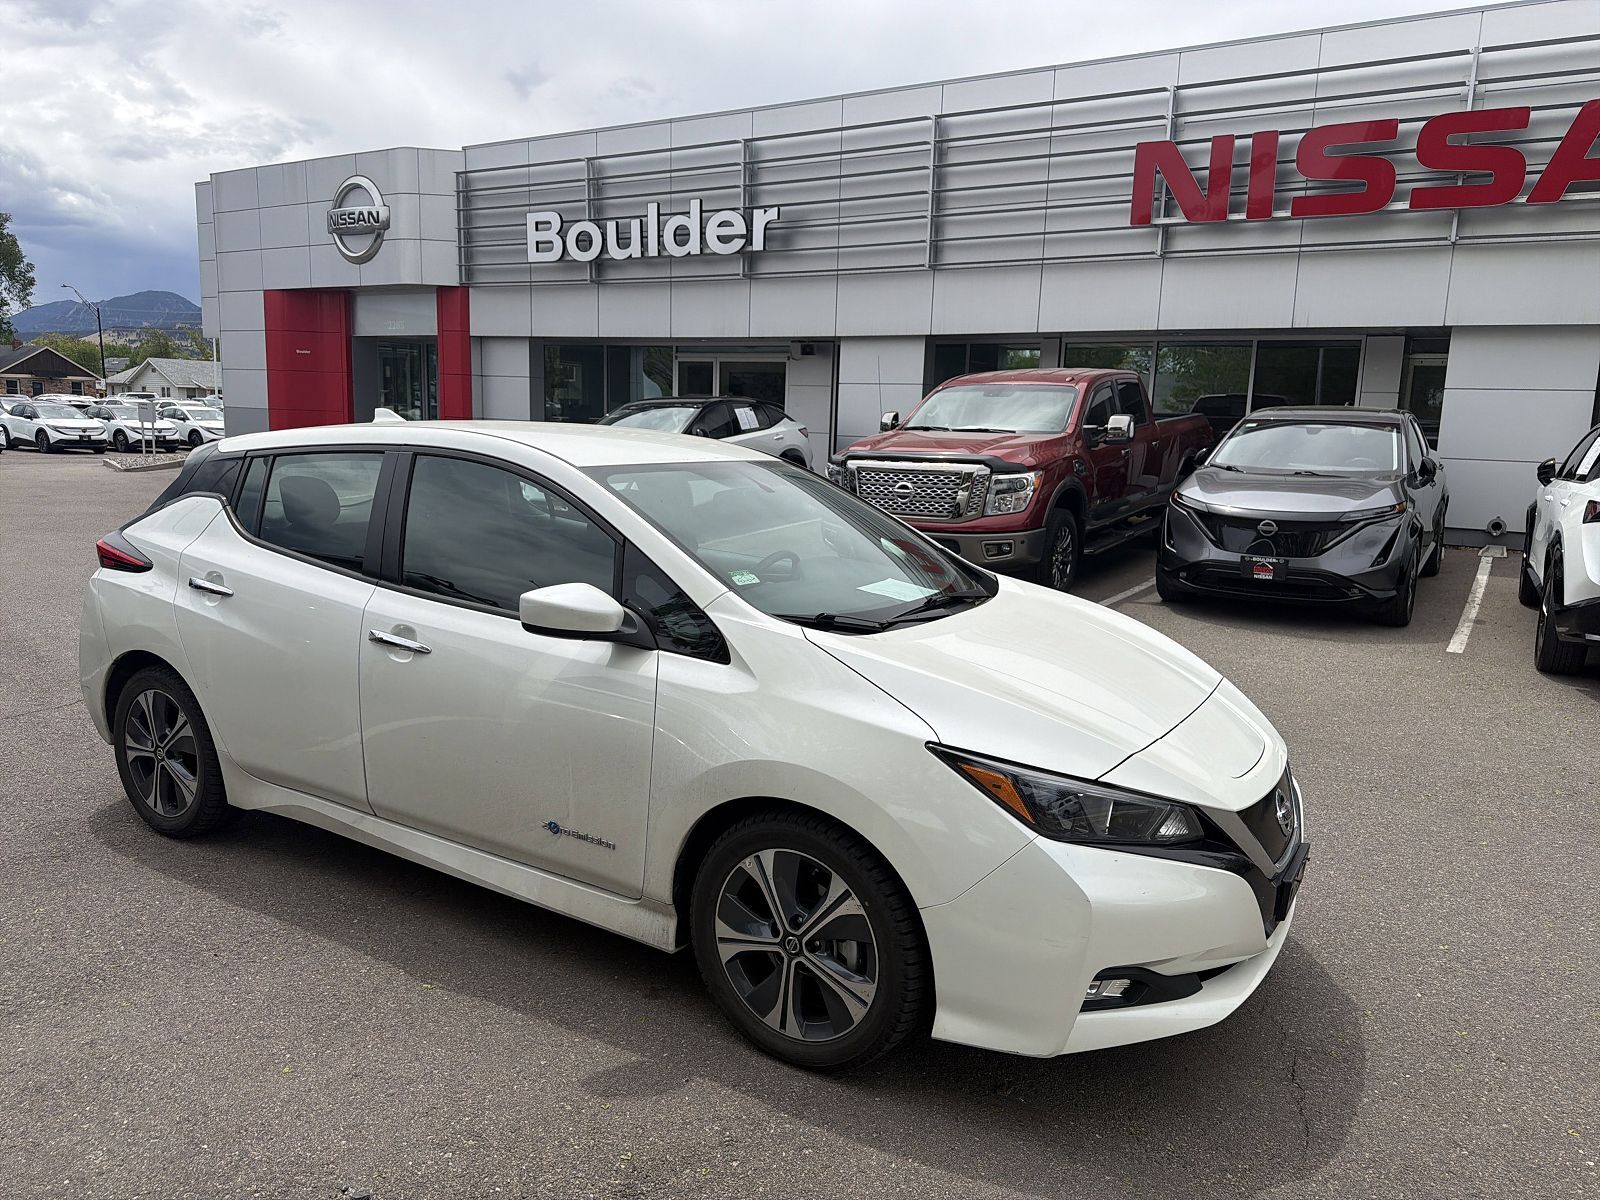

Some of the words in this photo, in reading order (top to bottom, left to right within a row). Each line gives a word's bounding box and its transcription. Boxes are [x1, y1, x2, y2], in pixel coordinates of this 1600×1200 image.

[330, 210, 380, 228] NISSAN
[526, 199, 780, 263] Boulder
[571, 829, 616, 850] Emission
